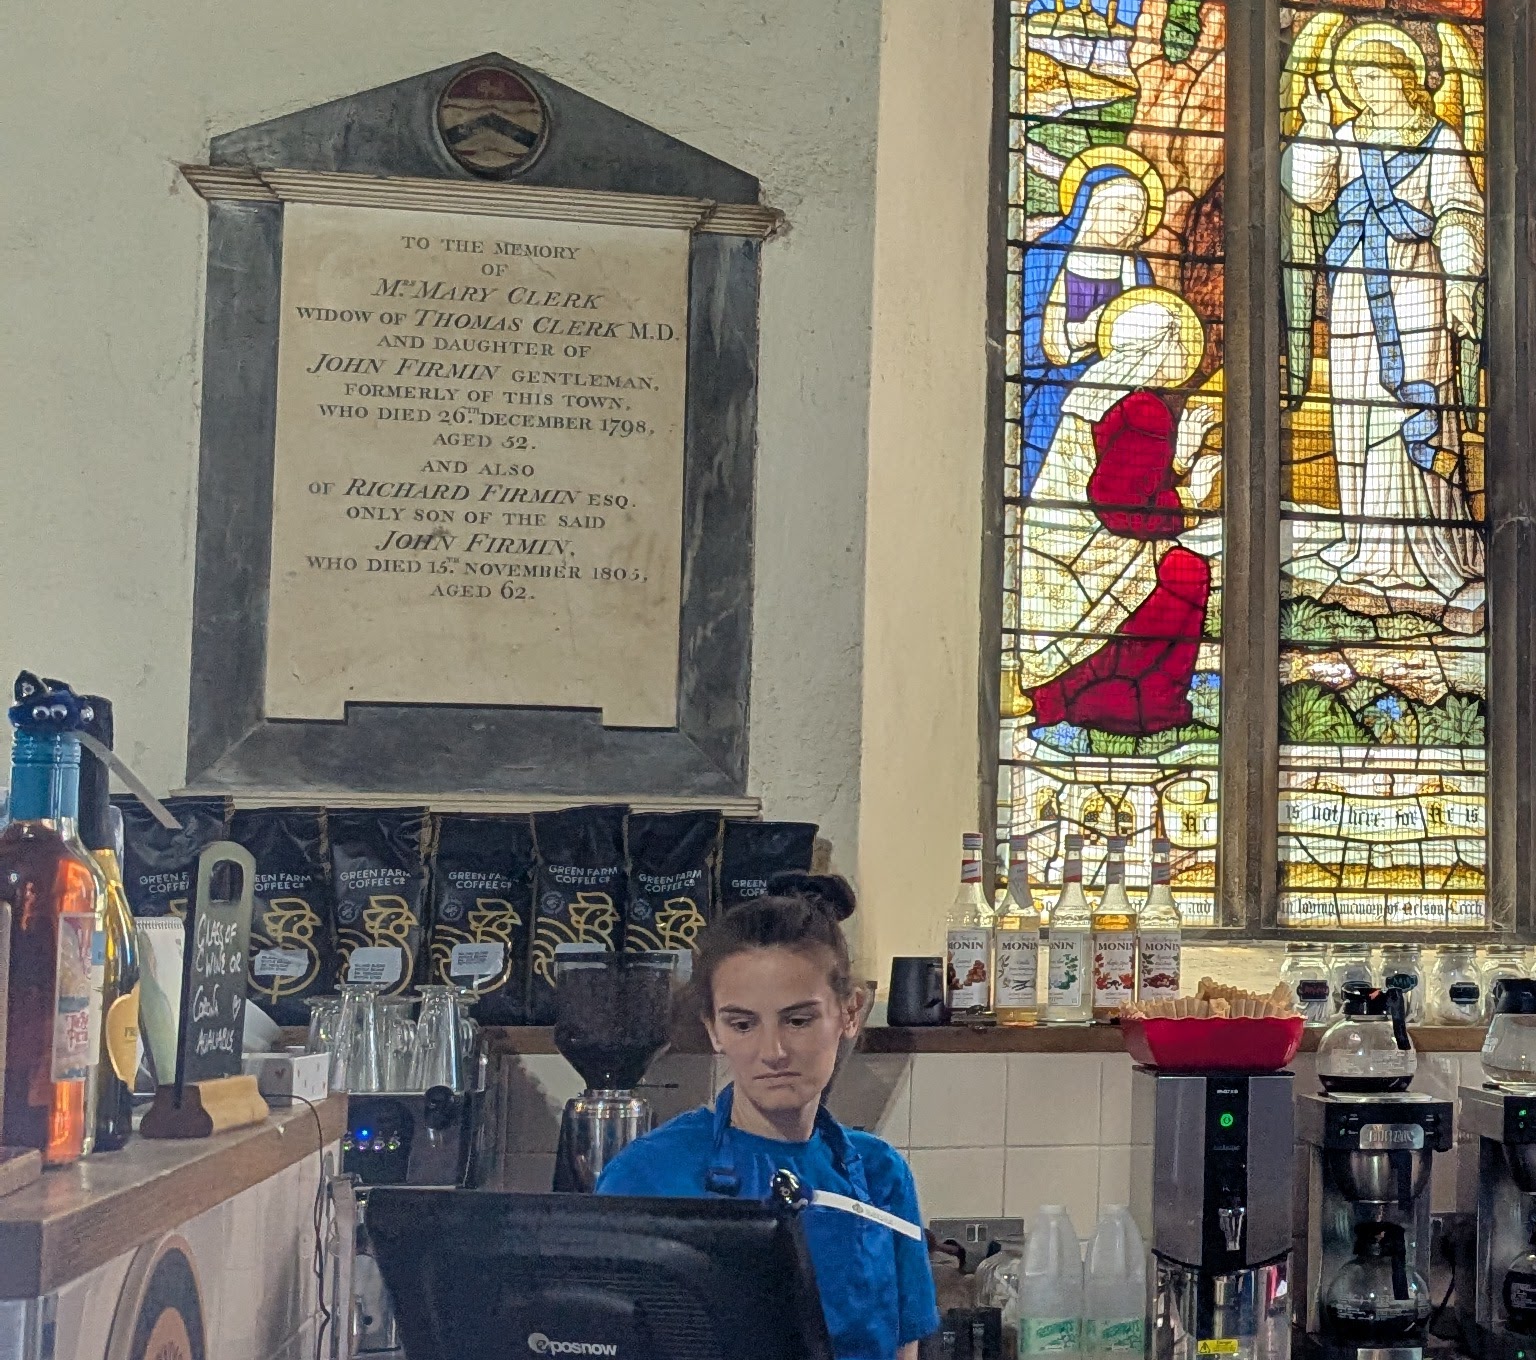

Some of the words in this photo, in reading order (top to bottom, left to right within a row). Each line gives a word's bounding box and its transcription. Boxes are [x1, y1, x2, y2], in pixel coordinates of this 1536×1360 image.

[401, 236, 430, 250] TO
[441, 240, 483, 254] THE
[493, 242, 580, 260] MEMORY
[481, 264, 509, 276] OF
[415, 282, 497, 303] MARY
[507, 287, 604, 310] CLERK
[296, 306, 374, 324] WIDOW
[379, 312, 407, 326] OF
[415, 309, 523, 332] THOMAS
[533, 317, 627, 337] CLERK
[628, 321, 679, 341] M.D.
[377, 335, 424, 349] AND
[434, 337, 554, 357] DAUGHTER
[564, 345, 591, 358] OF
[306, 353, 387, 374] JOHN
[394, 358, 500, 381] FIRMIN
[344, 383, 461, 401] FORMERLY
[467, 389, 493, 403] OF
[503, 392, 553, 406] THIS
[319, 404, 369, 419] WHO
[378, 406, 431, 421] DIED
[480, 412, 592, 431] DECEMBER
[433, 433, 492, 448] AGED
[420, 460, 468, 474] AND
[478, 463, 535, 477] ALSO
[308, 481, 335, 494] OF
[343, 479, 470, 501] RICHARD
[478, 484, 581, 506] FIRMIN
[587, 494, 636, 511] ESQ.
[346, 506, 406, 521] ONLY
[414, 508, 454, 523] SON
[464, 511, 492, 524] OF
[502, 513, 546, 526] THE
[558, 515, 605, 529] SAID
[375, 530, 456, 552] JOHN
[306, 556, 357, 571] WHO
[366, 559, 421, 573] DIED
[464, 561, 580, 580] NOVEMBER
[430, 583, 492, 598] AGED
[1286, 804, 1300, 819] is
[1312, 804, 1338, 823] not
[1466, 805, 1479, 823] is
[280, 873, 311, 882] FARM
[340, 869, 377, 881] GREEN
[380, 869, 411, 878] FARM
[449, 871, 486, 880] GREEN
[549, 864, 584, 876] GREEN
[587, 867, 617, 876] FARM
[139, 872, 179, 885] GREEN
[349, 878, 391, 889] COFFEE
[456, 880, 498, 889] COFFEE
[555, 875, 596, 884] COFFEE
[638, 873, 674, 884] GREEN
[732, 879, 767, 887] GREEN
[255, 882, 292, 891] OFFEE
[644, 882, 682, 893] COFFEE
[1339, 901, 1384, 921] memory
